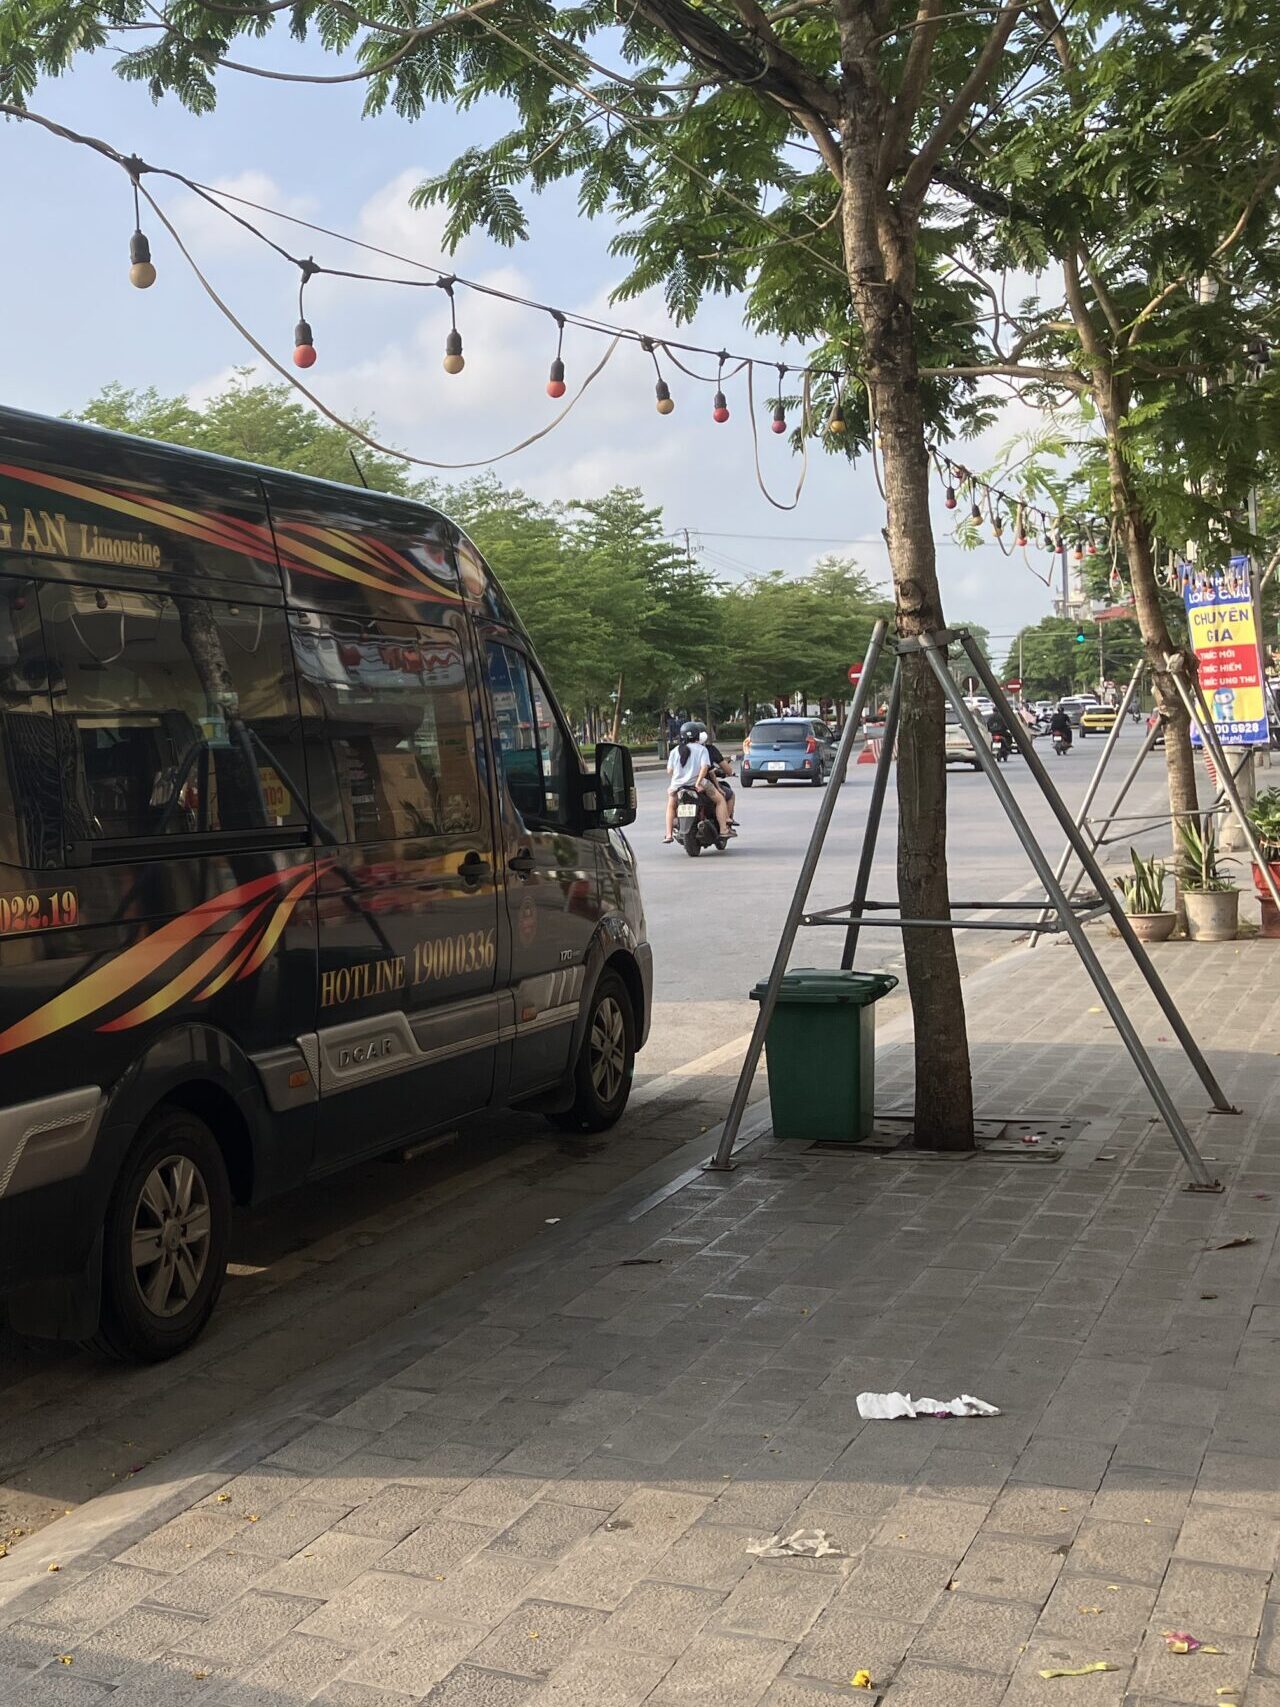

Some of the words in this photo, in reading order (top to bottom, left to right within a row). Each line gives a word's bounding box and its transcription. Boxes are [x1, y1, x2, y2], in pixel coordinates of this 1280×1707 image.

[20, 507, 69, 557] AN
[80, 523, 161, 568] Limousine
[1194, 607, 1249, 626] CHUYÊN
[1207, 628, 1233, 642] GIA
[411, 936, 454, 986] 1900
[455, 928, 495, 976] 0336
[321, 955, 406, 1008] HOTLINE
[338, 1037, 393, 1068] DCAR
